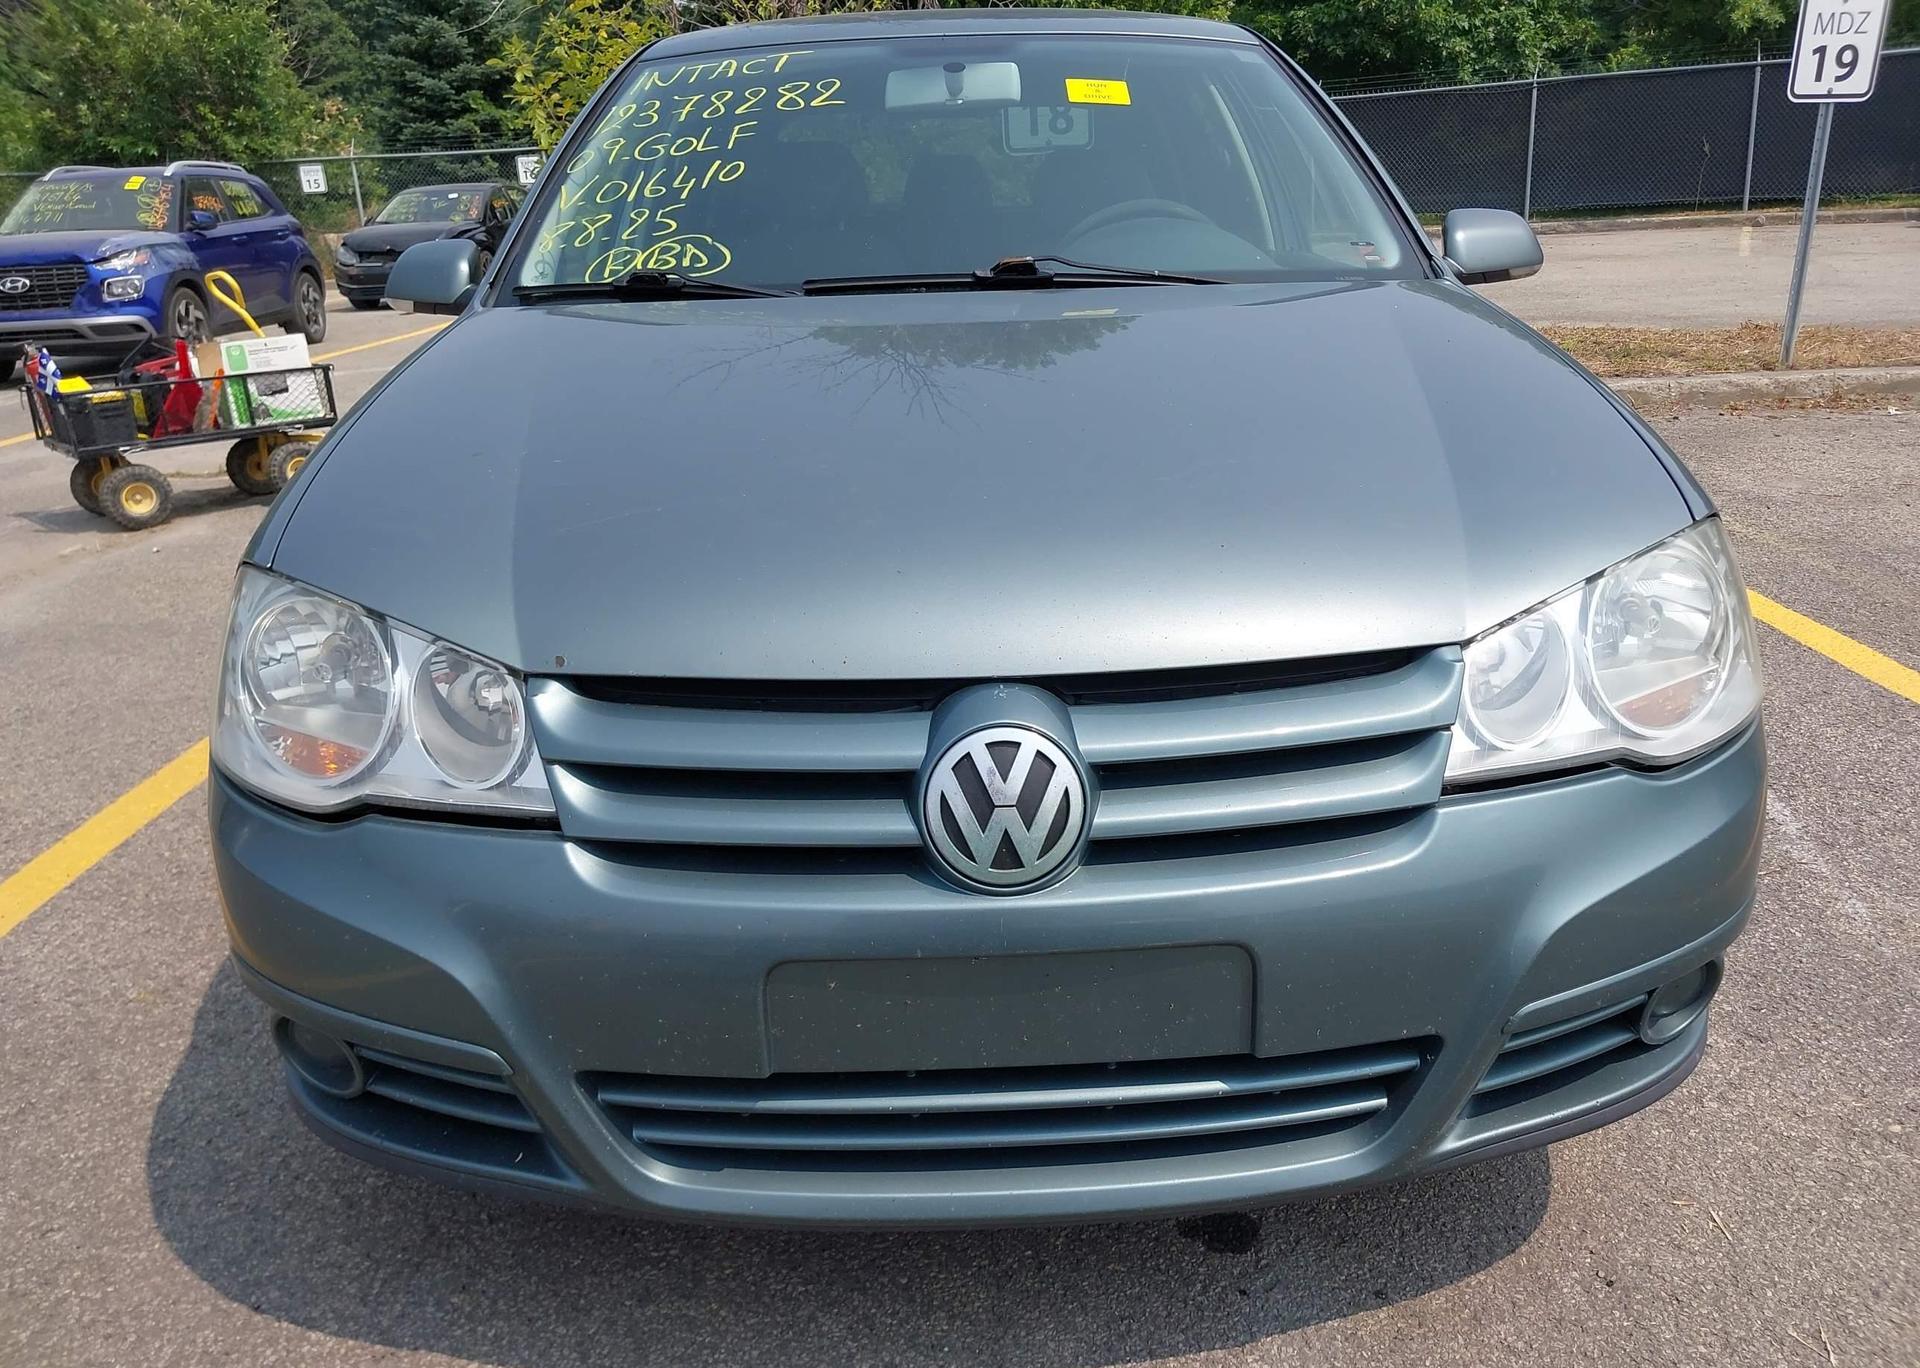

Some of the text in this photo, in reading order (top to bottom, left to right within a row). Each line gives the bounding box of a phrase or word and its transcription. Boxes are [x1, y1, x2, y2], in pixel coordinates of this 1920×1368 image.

[1813, 11, 1872, 35] MDZ
[630, 51, 815, 95] INTACT
[1812, 44, 1859, 83] 19
[1022, 105, 1074, 136] 18
[306, 179, 321, 190] 15
[933, 733, 1078, 880] VW
